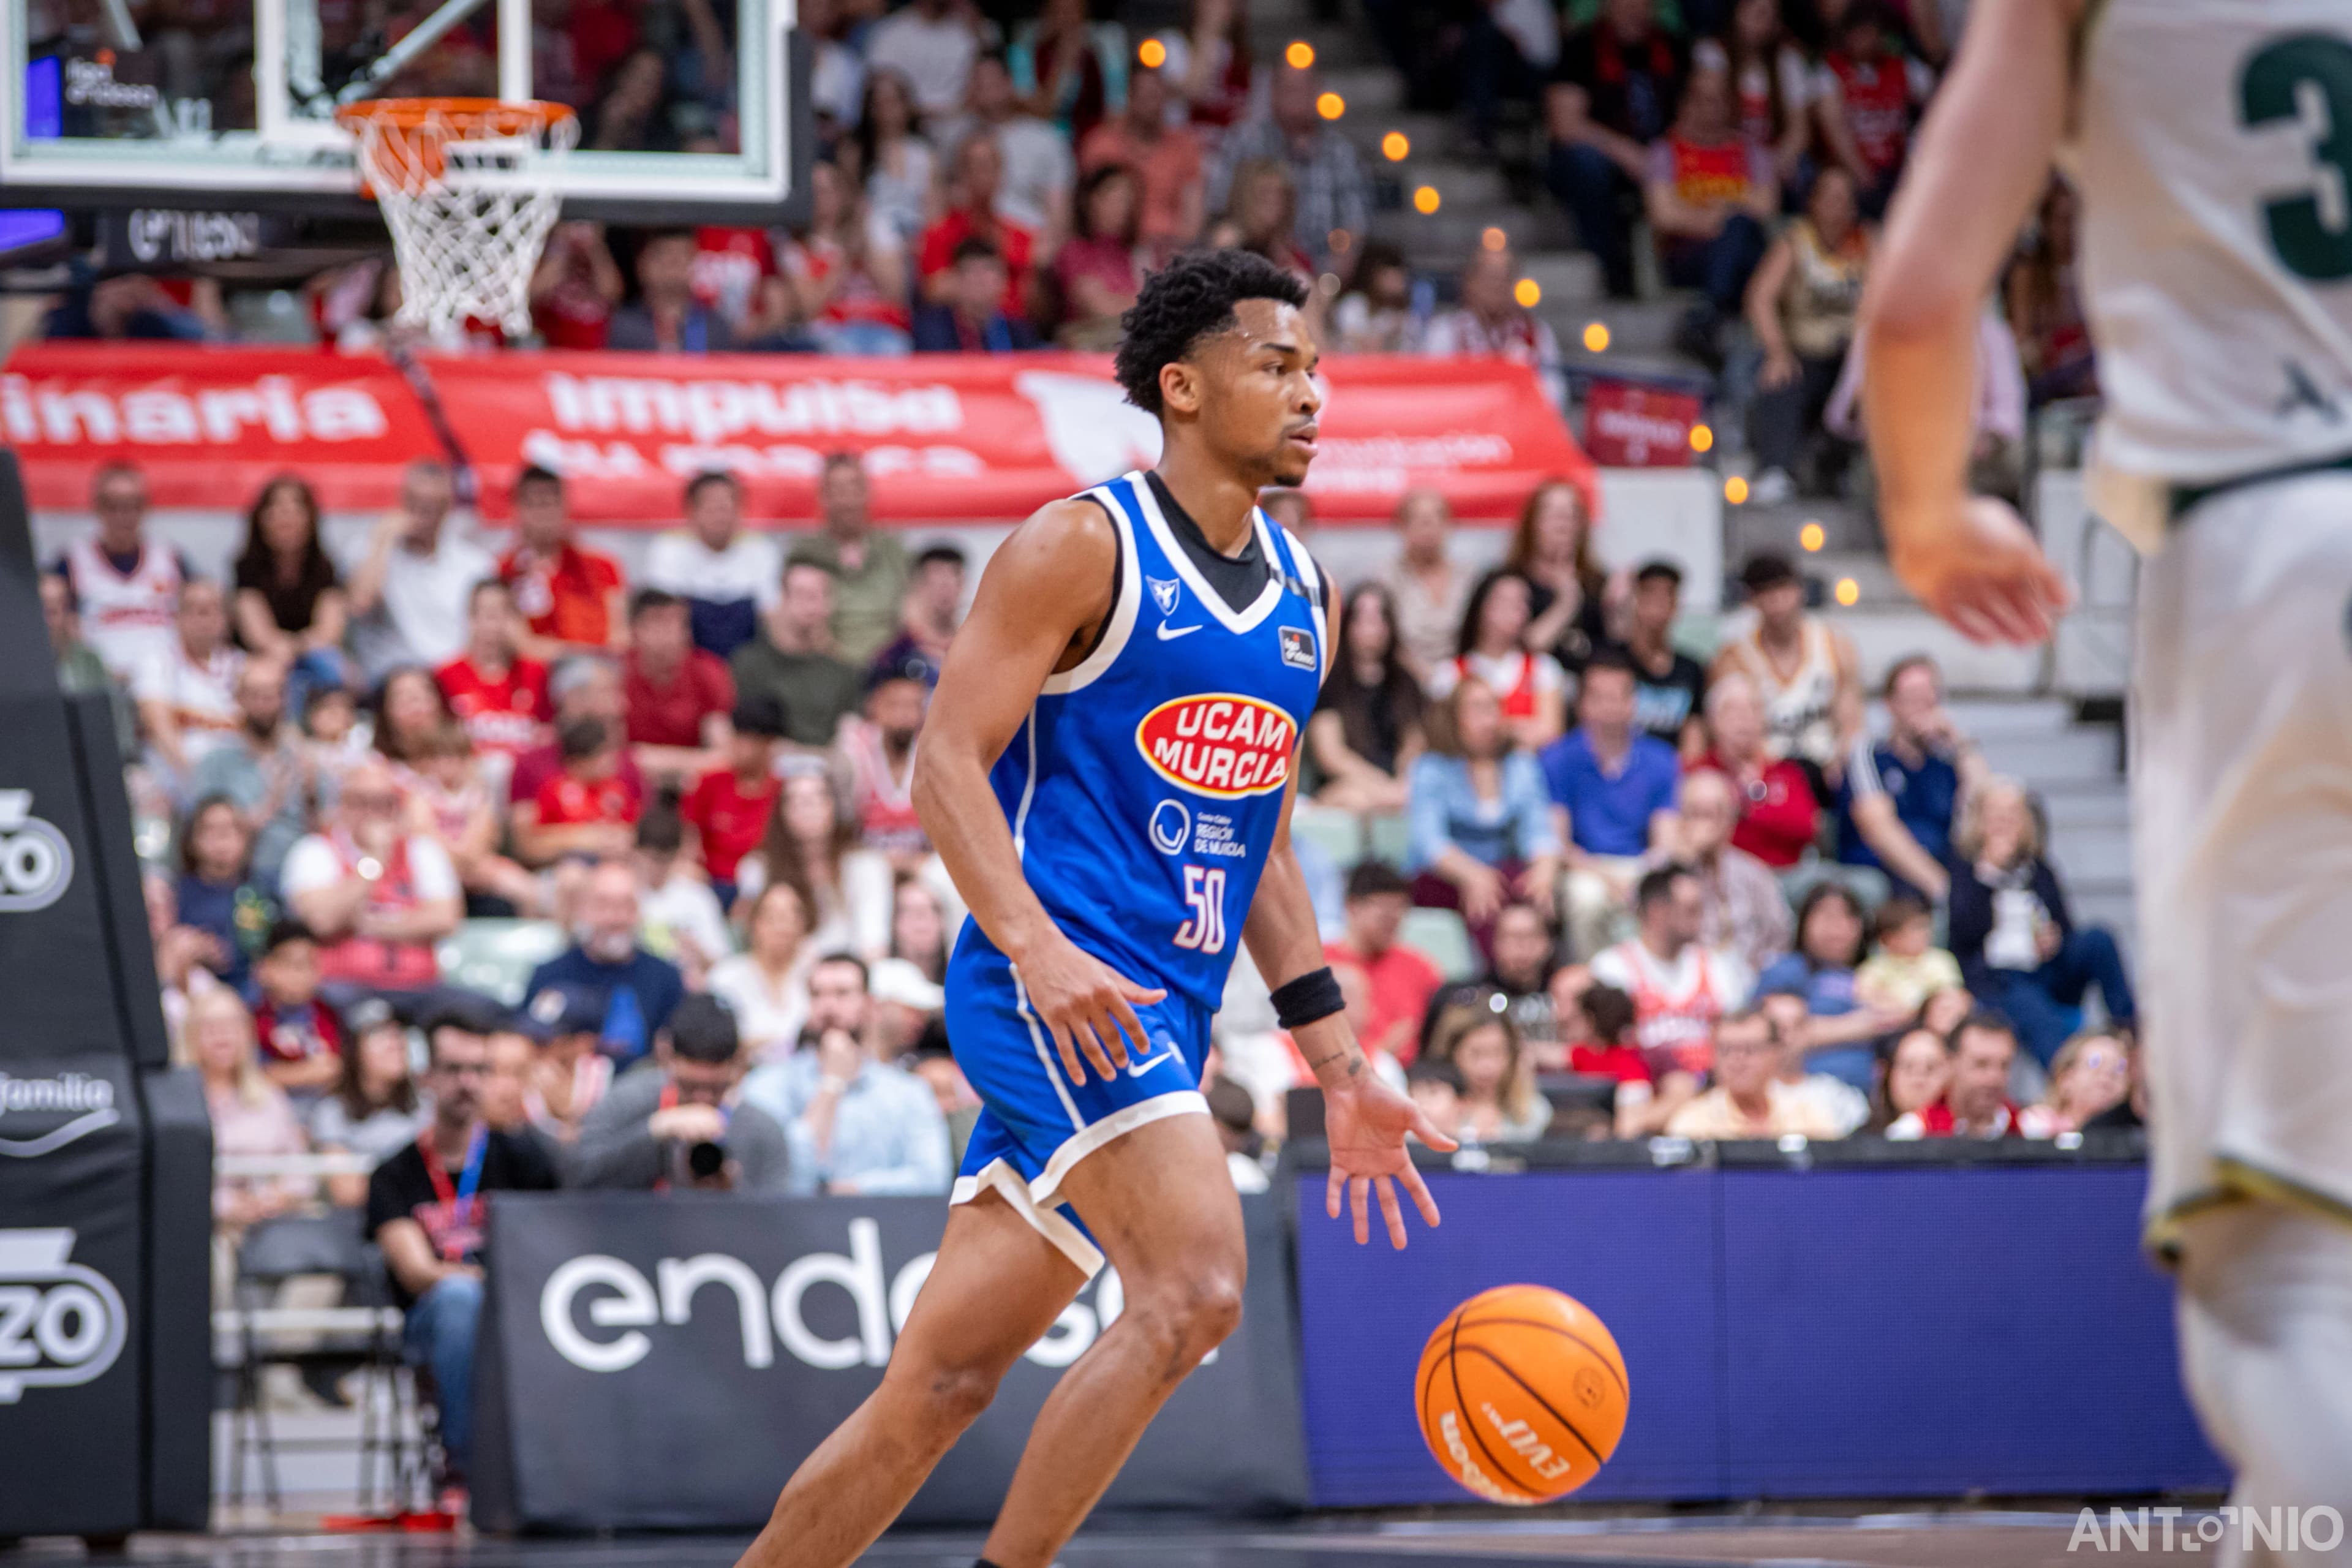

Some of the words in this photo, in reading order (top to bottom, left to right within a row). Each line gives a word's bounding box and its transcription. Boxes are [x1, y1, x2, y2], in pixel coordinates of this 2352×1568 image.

[1176, 702, 1287, 752] UCAM
[1154, 737, 1286, 788] MURCIA
[1173, 864, 1226, 954] 50
[540, 1218, 1218, 1371] ends
